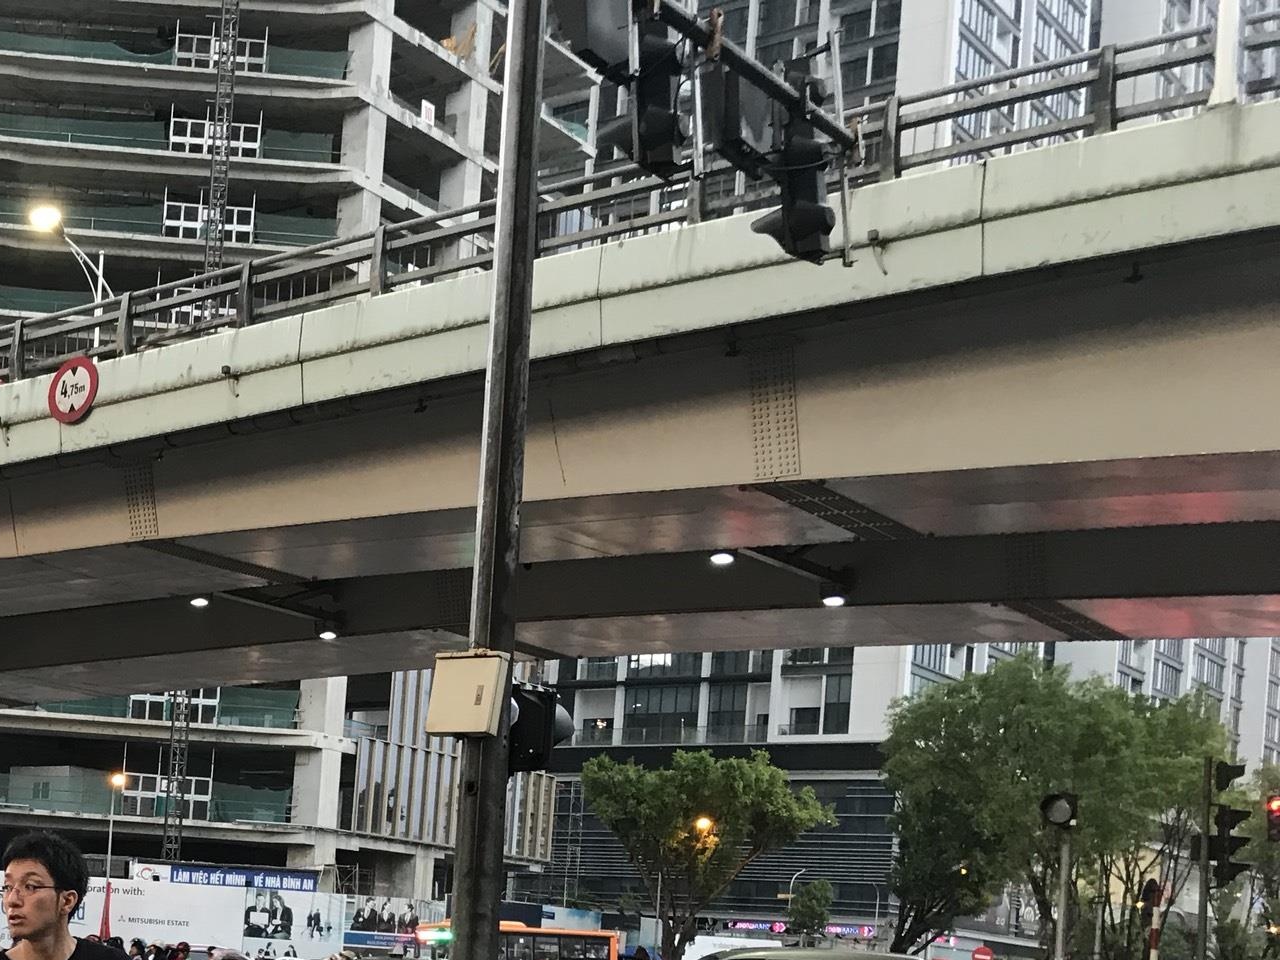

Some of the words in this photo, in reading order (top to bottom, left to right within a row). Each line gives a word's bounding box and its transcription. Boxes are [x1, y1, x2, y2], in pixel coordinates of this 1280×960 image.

[60, 380, 86, 399] 4,75m
[173, 869, 190, 882] LÀM
[225, 872, 246, 886] MÌNH
[265, 875, 280, 888] NHÀ
[282, 876, 301, 890] BÌNH
[302, 879, 314, 891] AN
[122, 888, 145, 896] with:
[128, 917, 166, 925] MITSUBISHI
